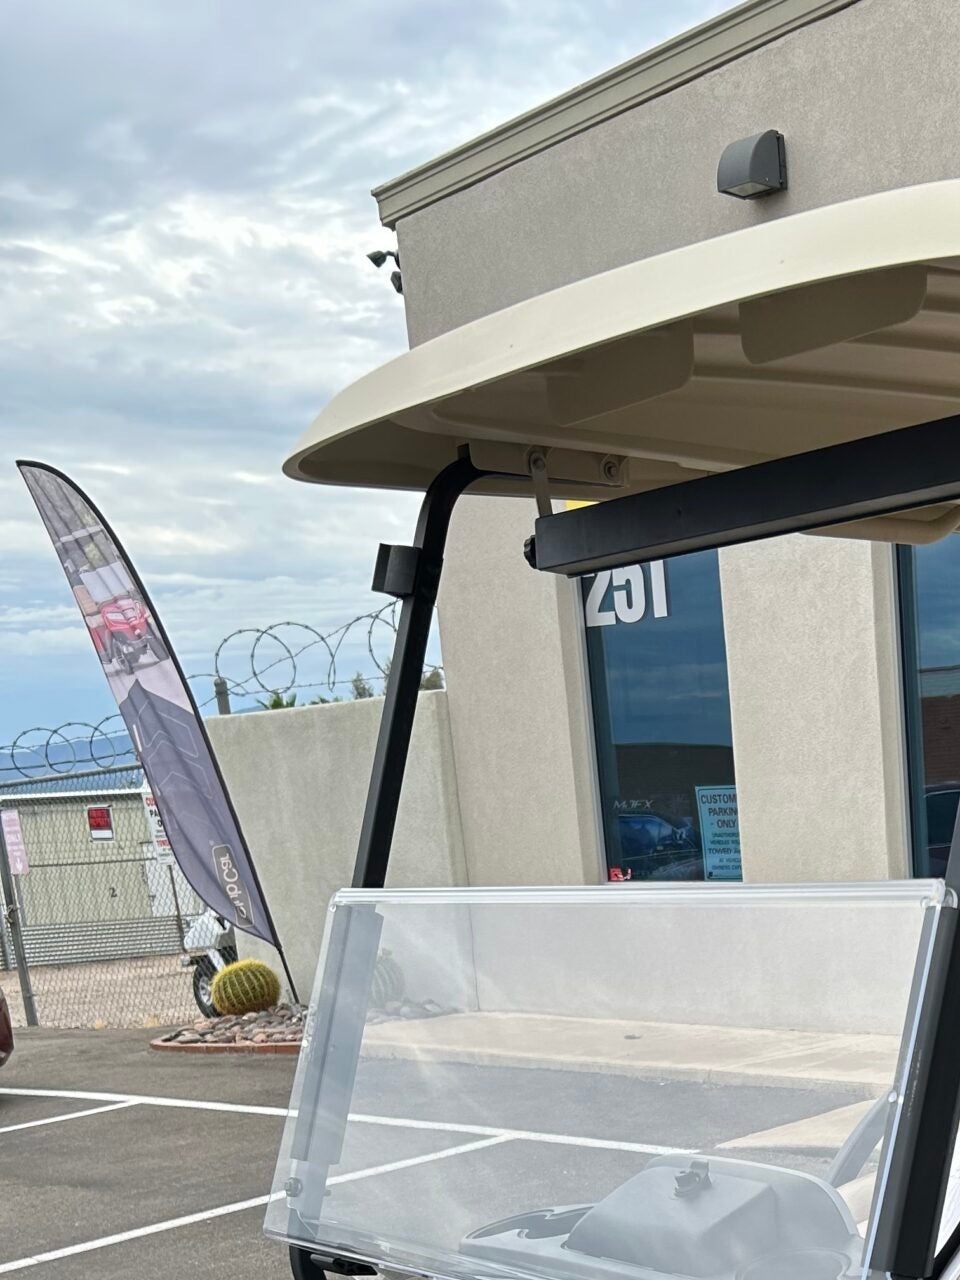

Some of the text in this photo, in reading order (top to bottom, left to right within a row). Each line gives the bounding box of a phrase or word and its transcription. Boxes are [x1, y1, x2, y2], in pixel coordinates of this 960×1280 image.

[582, 559, 668, 628] 251
[701, 794, 737, 804] CUSTOM
[708, 807, 738, 816] PARKIN
[717, 819, 737, 828] ONLY
